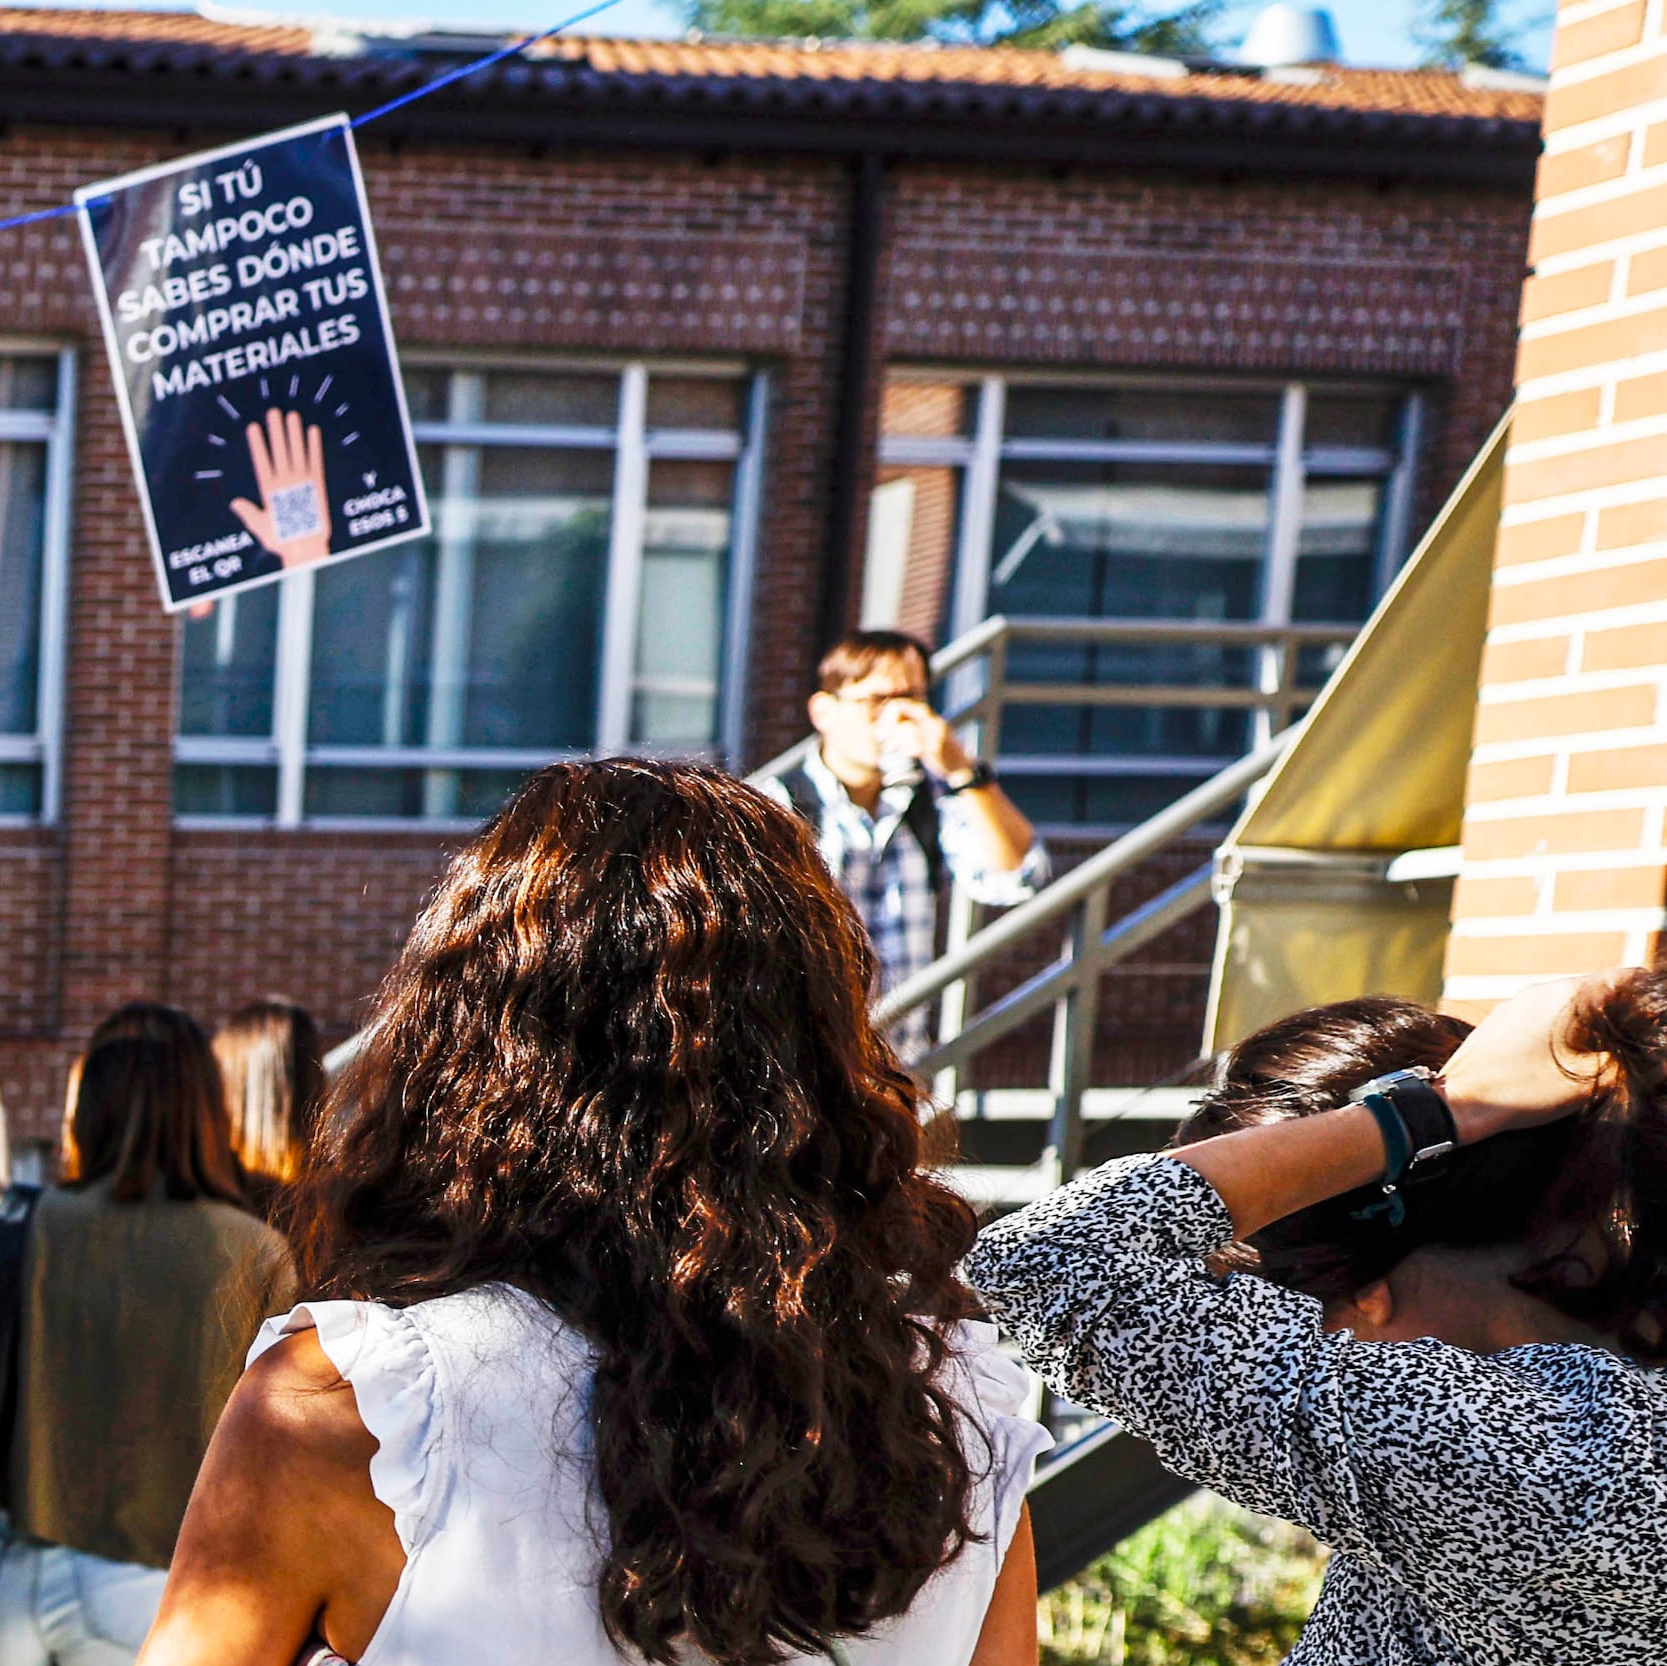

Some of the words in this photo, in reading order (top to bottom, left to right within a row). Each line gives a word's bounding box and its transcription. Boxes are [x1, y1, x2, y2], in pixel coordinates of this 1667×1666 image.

[179, 182, 212, 216] SI
[216, 159, 264, 205] TÚ
[140, 196, 314, 271] TAMPOCO
[117, 264, 233, 323] SABES
[237, 225, 361, 289] DÓNDE
[126, 288, 299, 364] COMPRAR
[301, 267, 369, 313] TUS
[152, 313, 361, 401] MATERIALES
[343, 484, 407, 518] CHOCA
[169, 530, 255, 570] ESCANEA
[188, 566, 213, 586] EL
